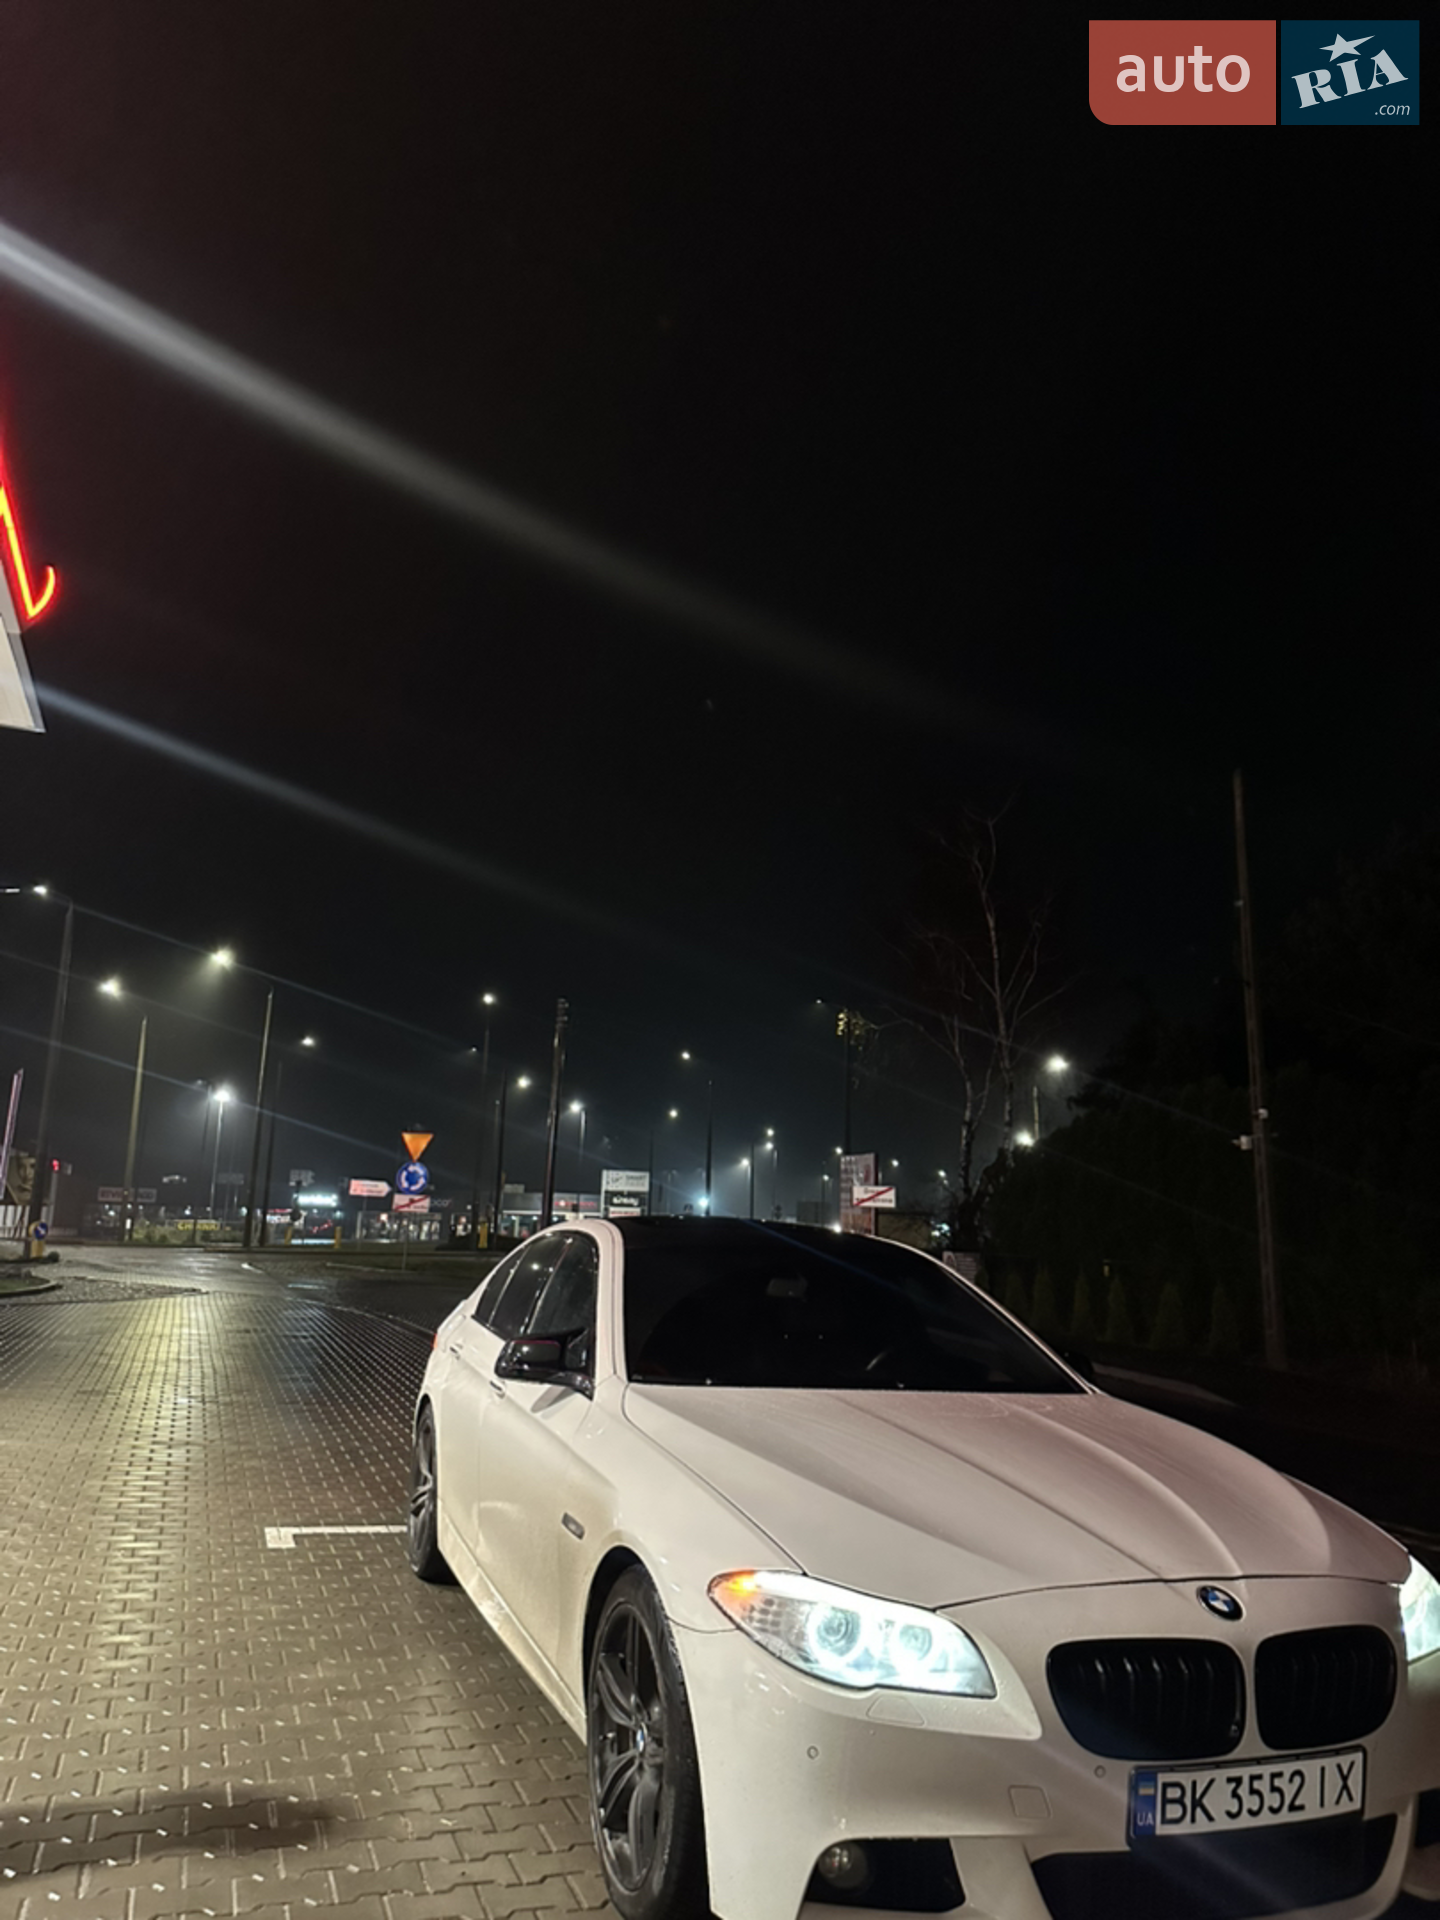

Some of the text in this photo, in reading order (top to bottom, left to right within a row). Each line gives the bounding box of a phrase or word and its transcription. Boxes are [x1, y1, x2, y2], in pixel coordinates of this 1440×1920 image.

[1160, 1759, 1356, 1826] BK 3552 IX
[1137, 1812, 1154, 1827] UA
